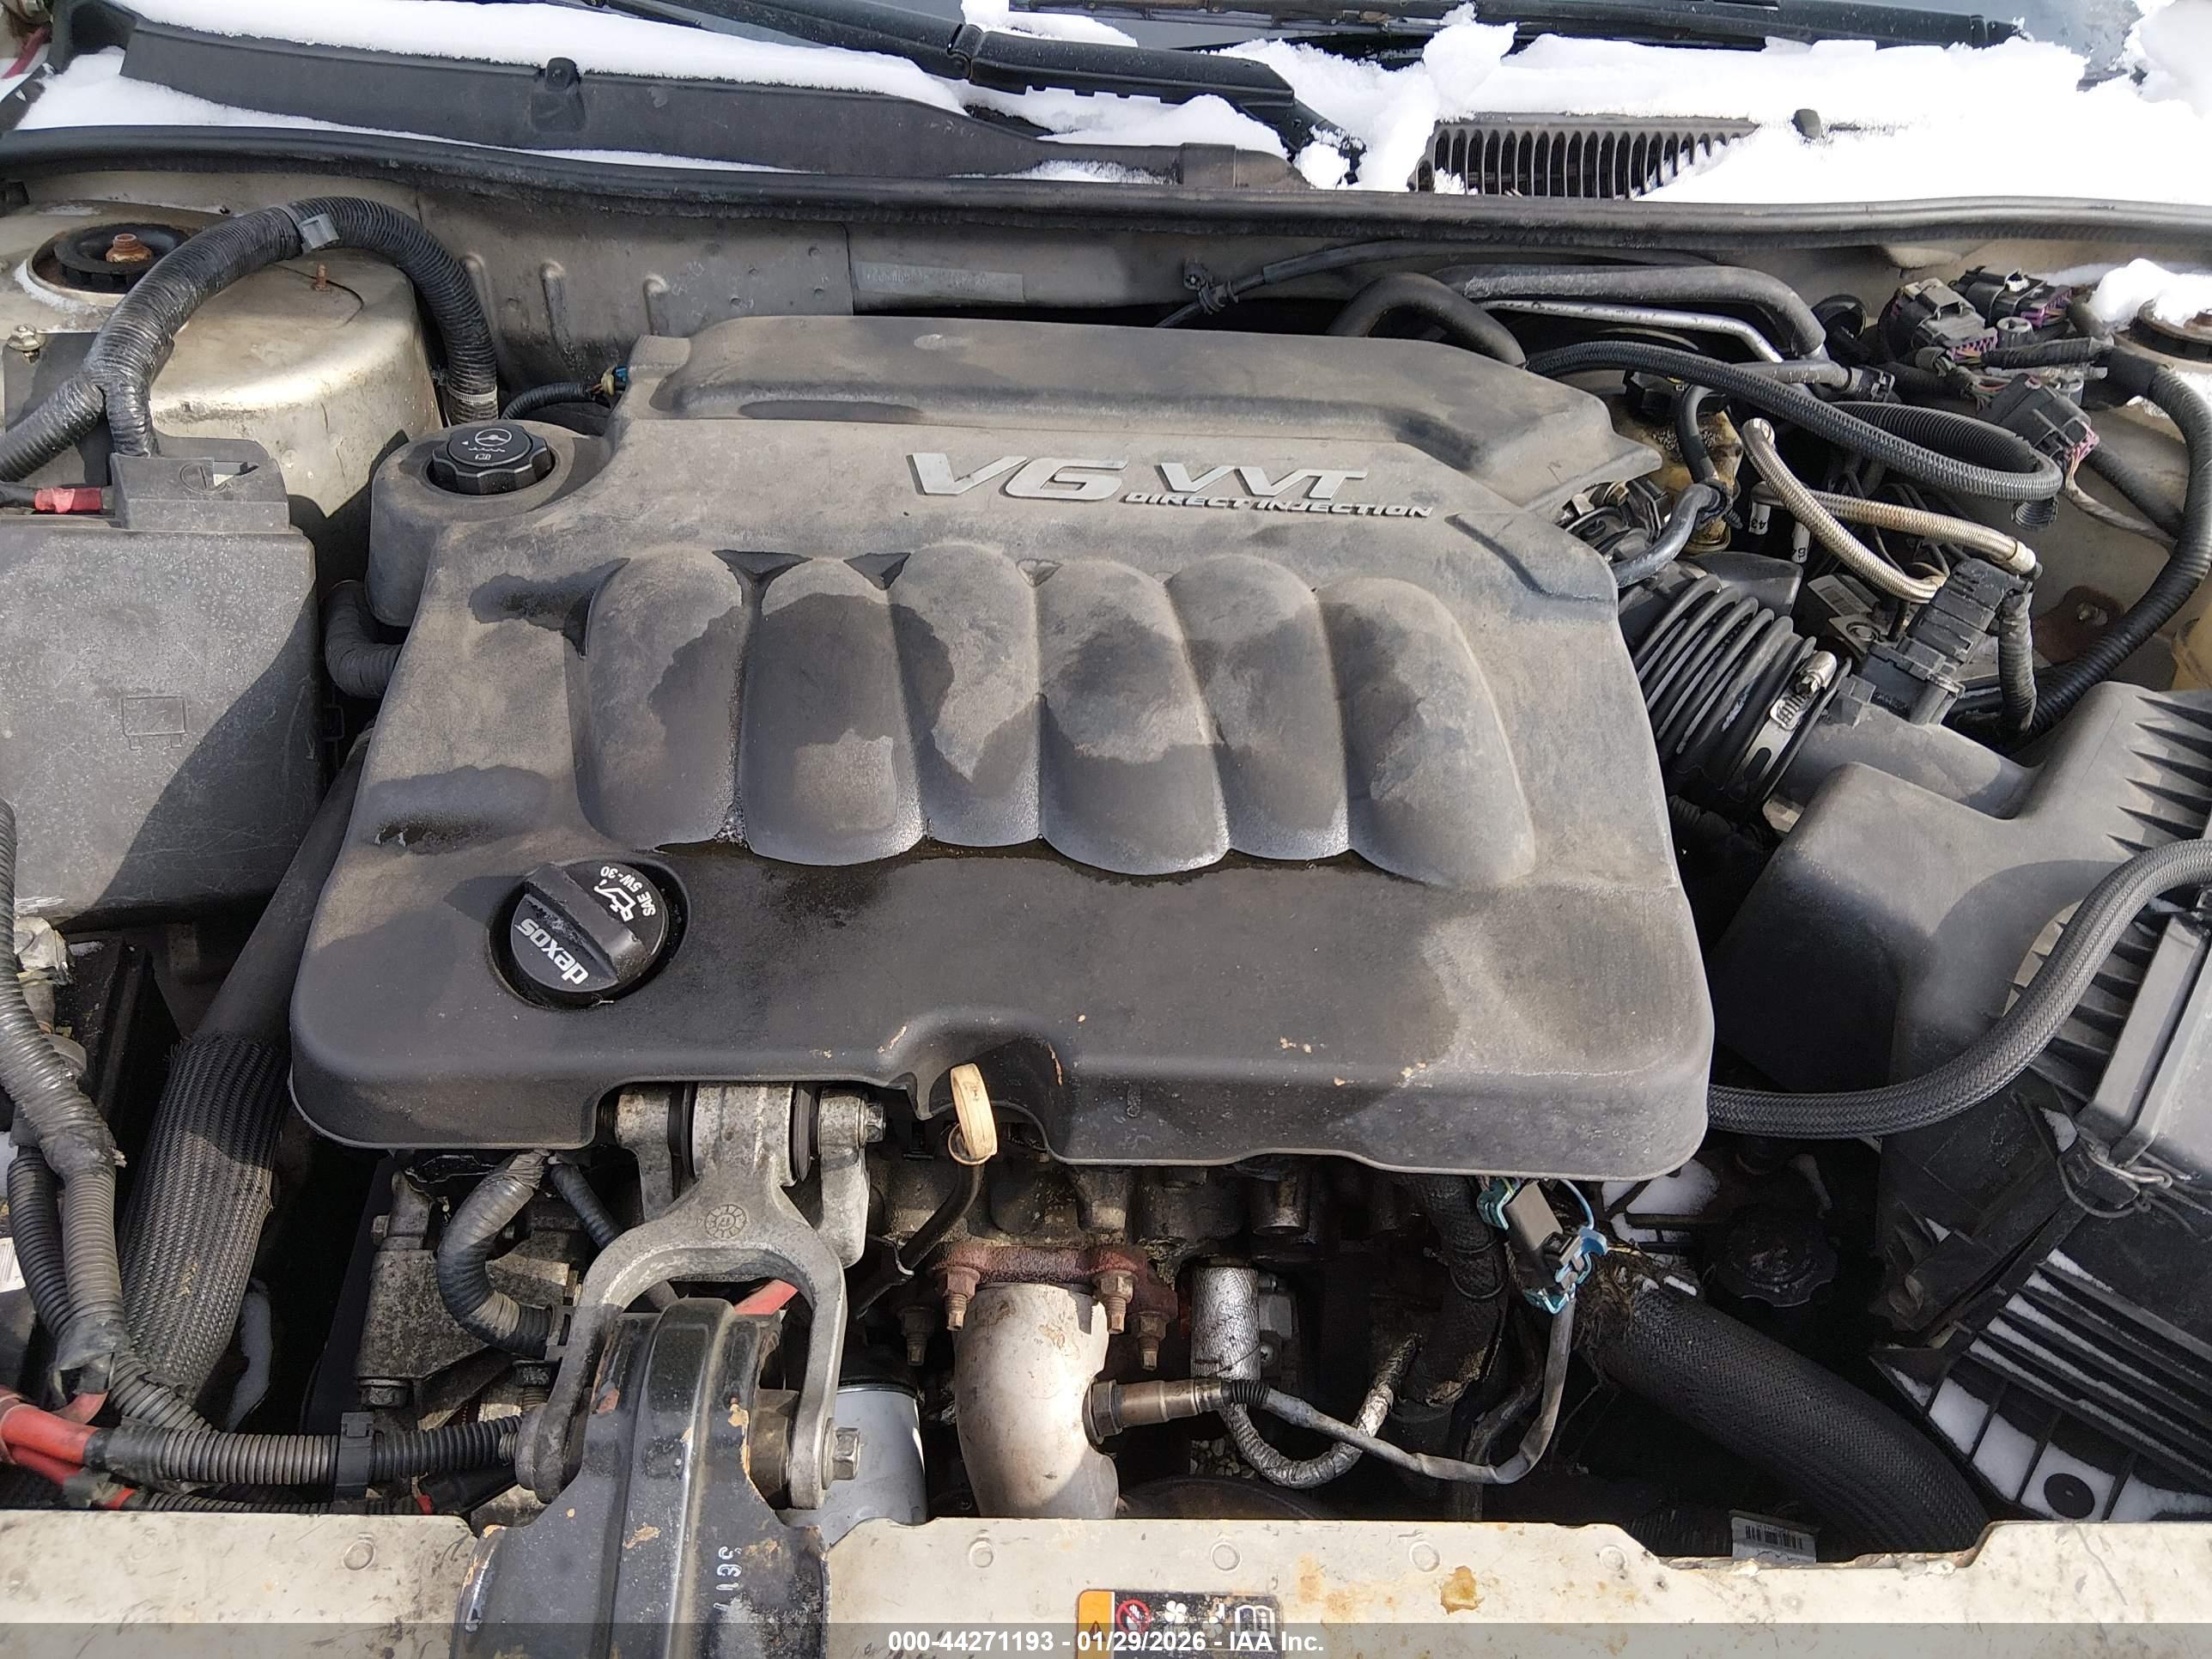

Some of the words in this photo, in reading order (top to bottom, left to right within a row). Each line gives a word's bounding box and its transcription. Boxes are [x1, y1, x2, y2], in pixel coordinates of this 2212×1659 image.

[908, 453, 1127, 501] V6
[1158, 462, 1368, 500] VVT
[1123, 491, 1249, 508] DIRECT
[1255, 498, 1434, 517] INJECTION
[601, 866, 643, 893] 5W-30
[636, 891, 656, 916] SAE
[514, 918, 589, 985] dexos
